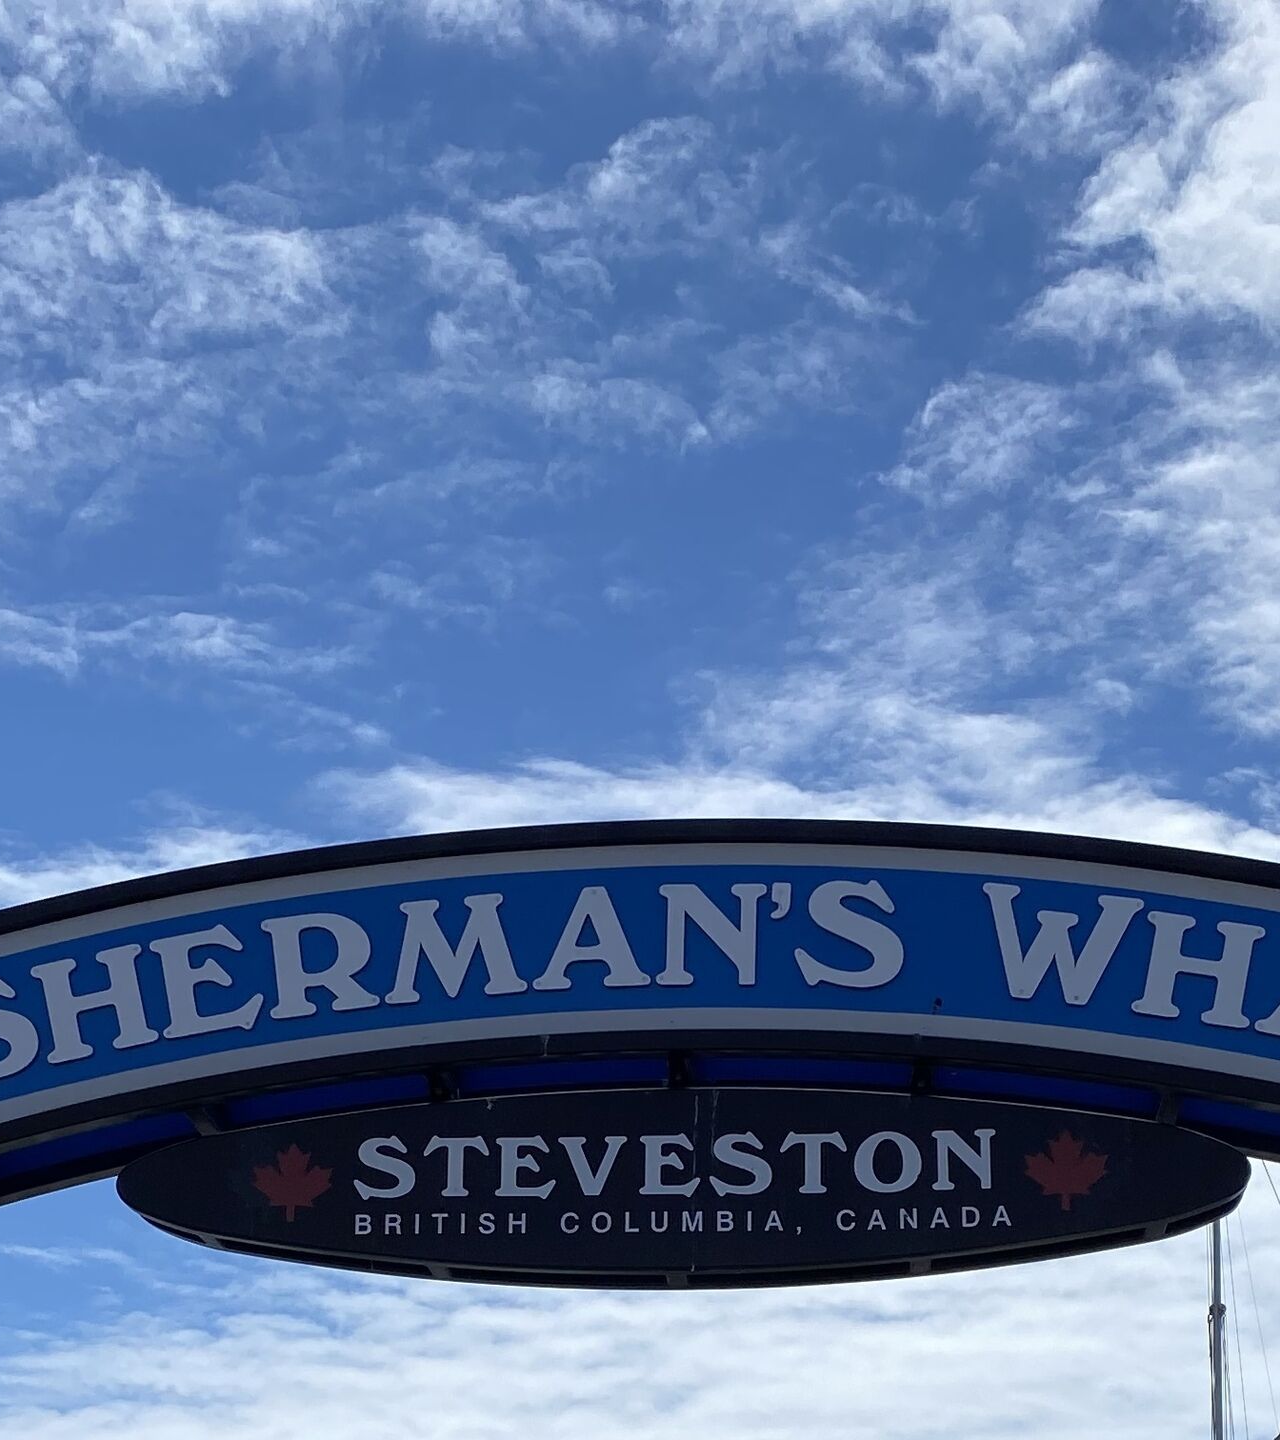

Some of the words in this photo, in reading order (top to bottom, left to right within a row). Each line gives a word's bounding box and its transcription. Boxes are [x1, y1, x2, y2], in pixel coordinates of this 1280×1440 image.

[353, 1128, 997, 1200] STEVESTON
[354, 1212, 530, 1236] BRITISH
[559, 1209, 804, 1237] COLUMBIA,
[835, 1204, 1013, 1232] CANADA
